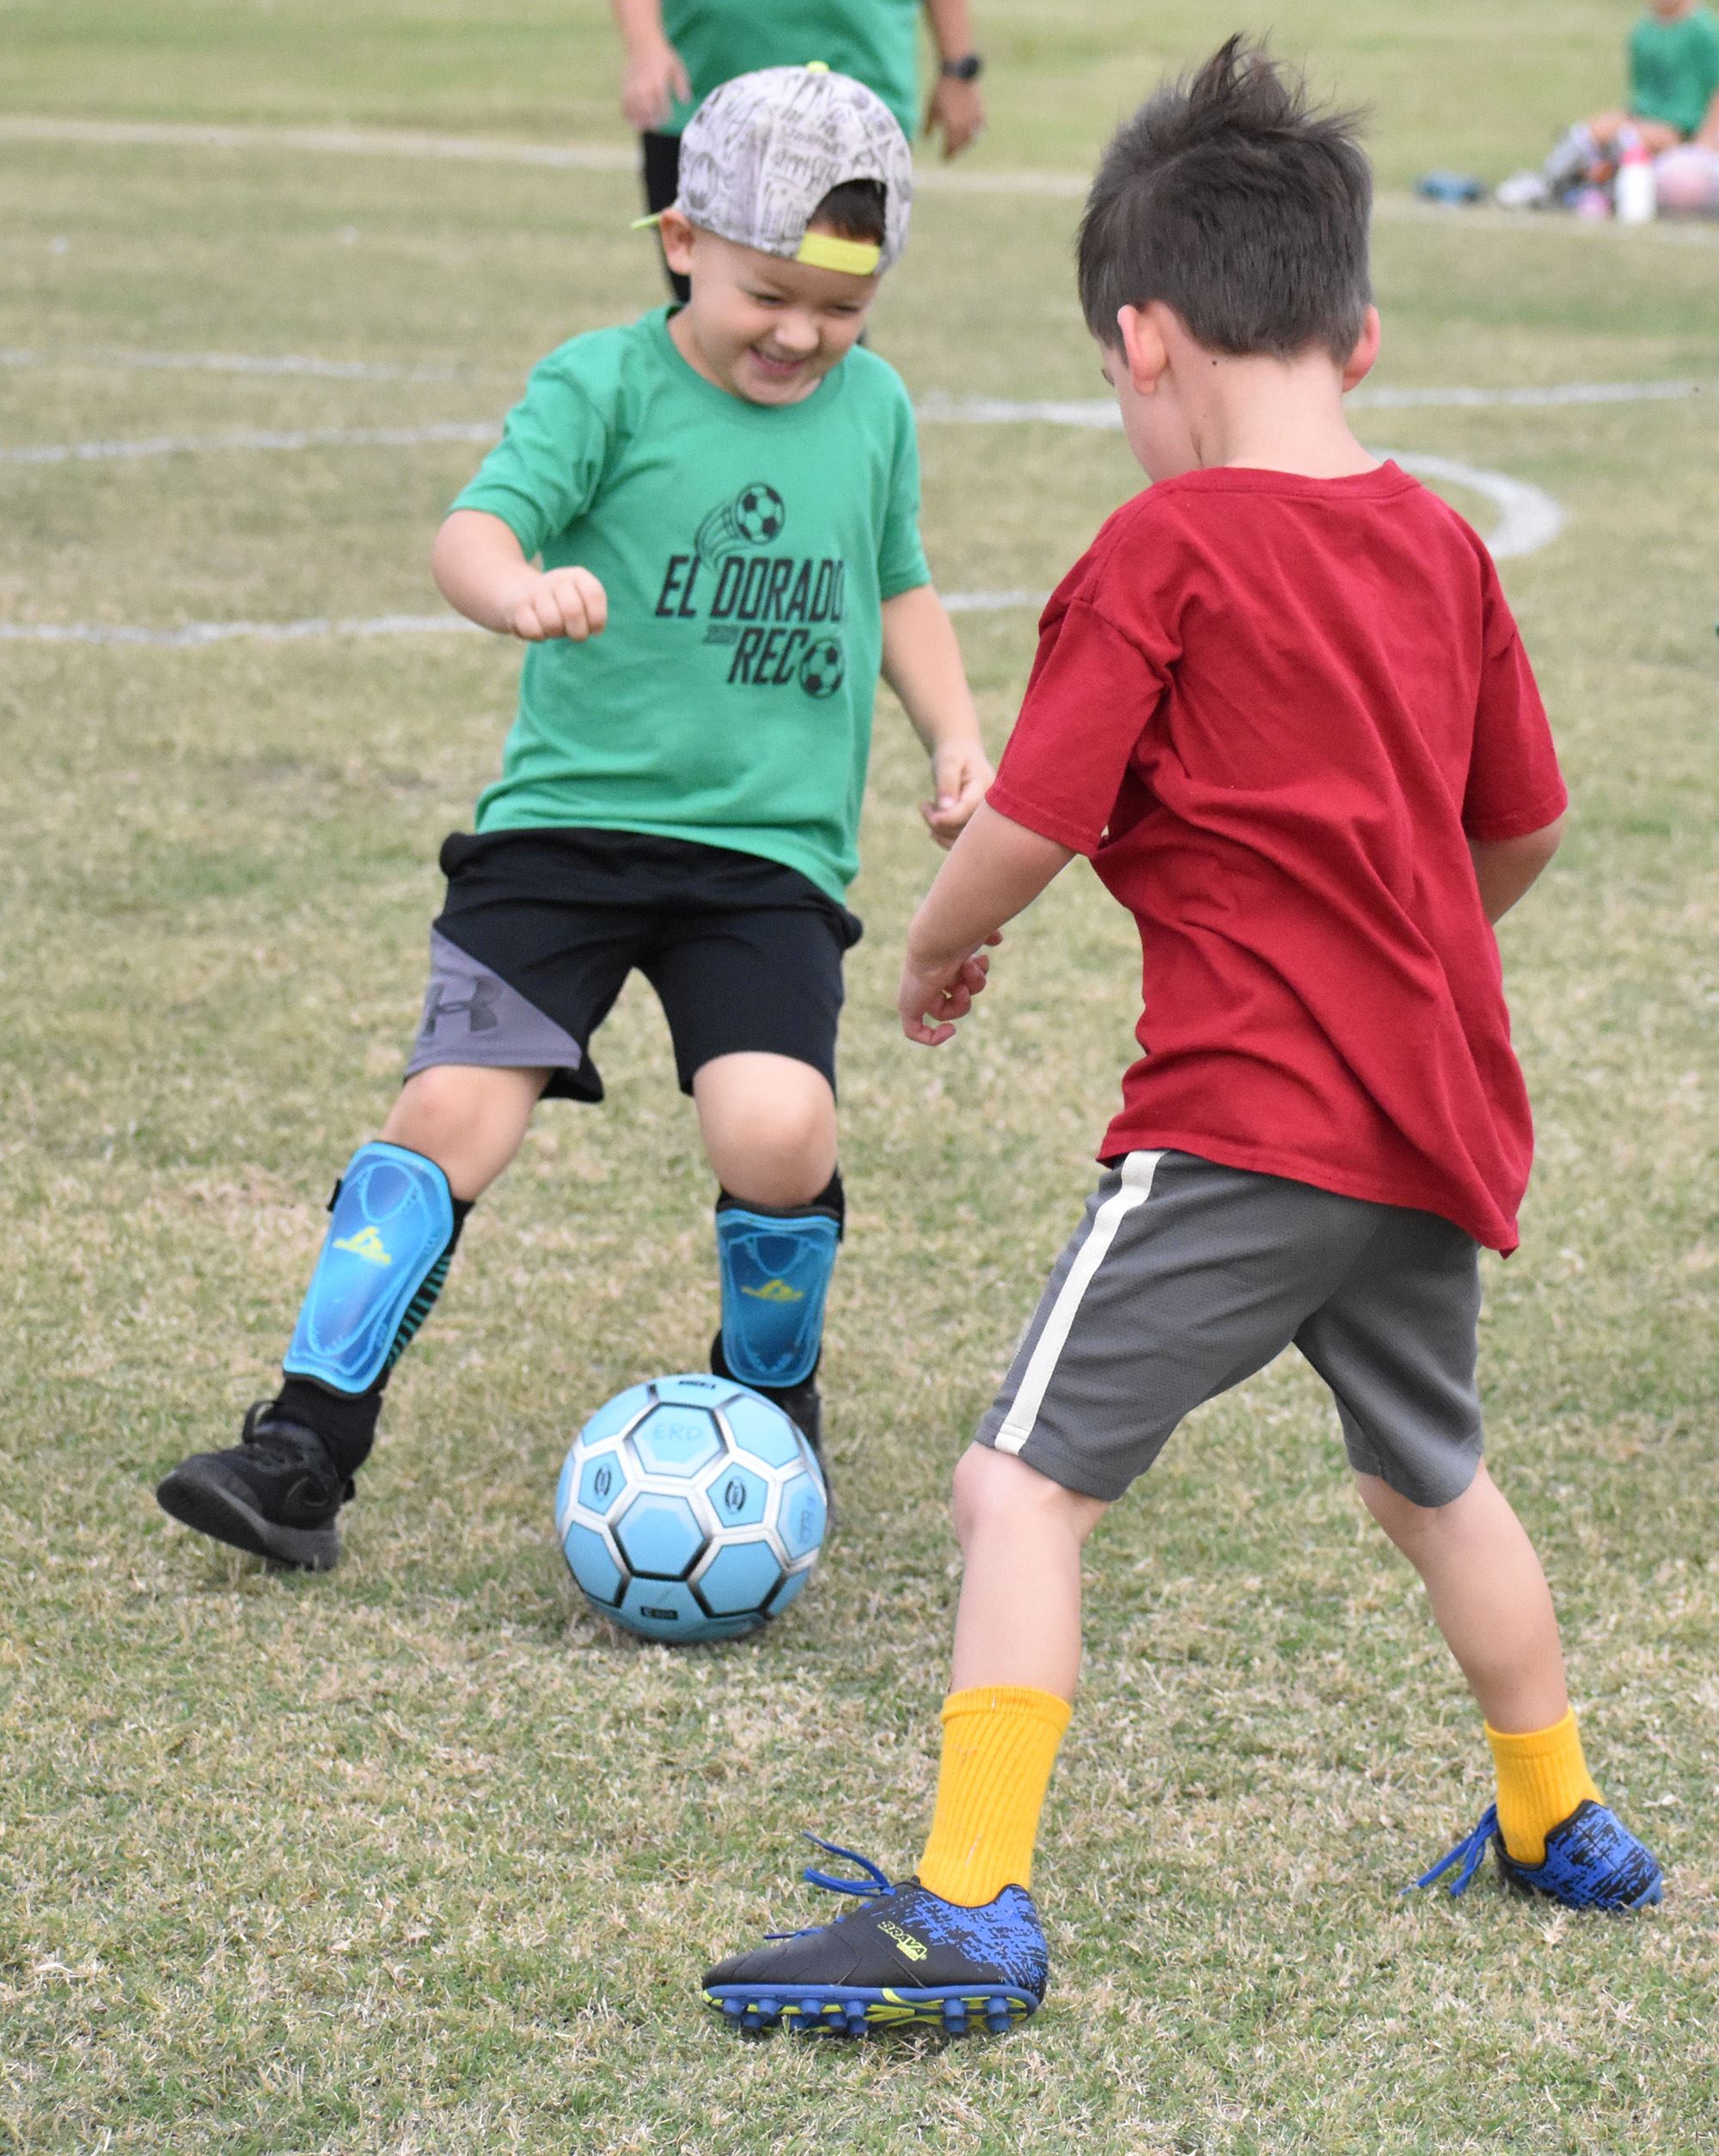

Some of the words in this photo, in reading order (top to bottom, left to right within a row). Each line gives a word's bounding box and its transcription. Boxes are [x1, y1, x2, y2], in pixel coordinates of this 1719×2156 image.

[655, 554, 701, 618] EL
[710, 555, 844, 623] DORADO
[727, 627, 811, 685] REC
[654, 1422, 703, 1441] ERD
[877, 1920, 927, 1957] BRAVA
